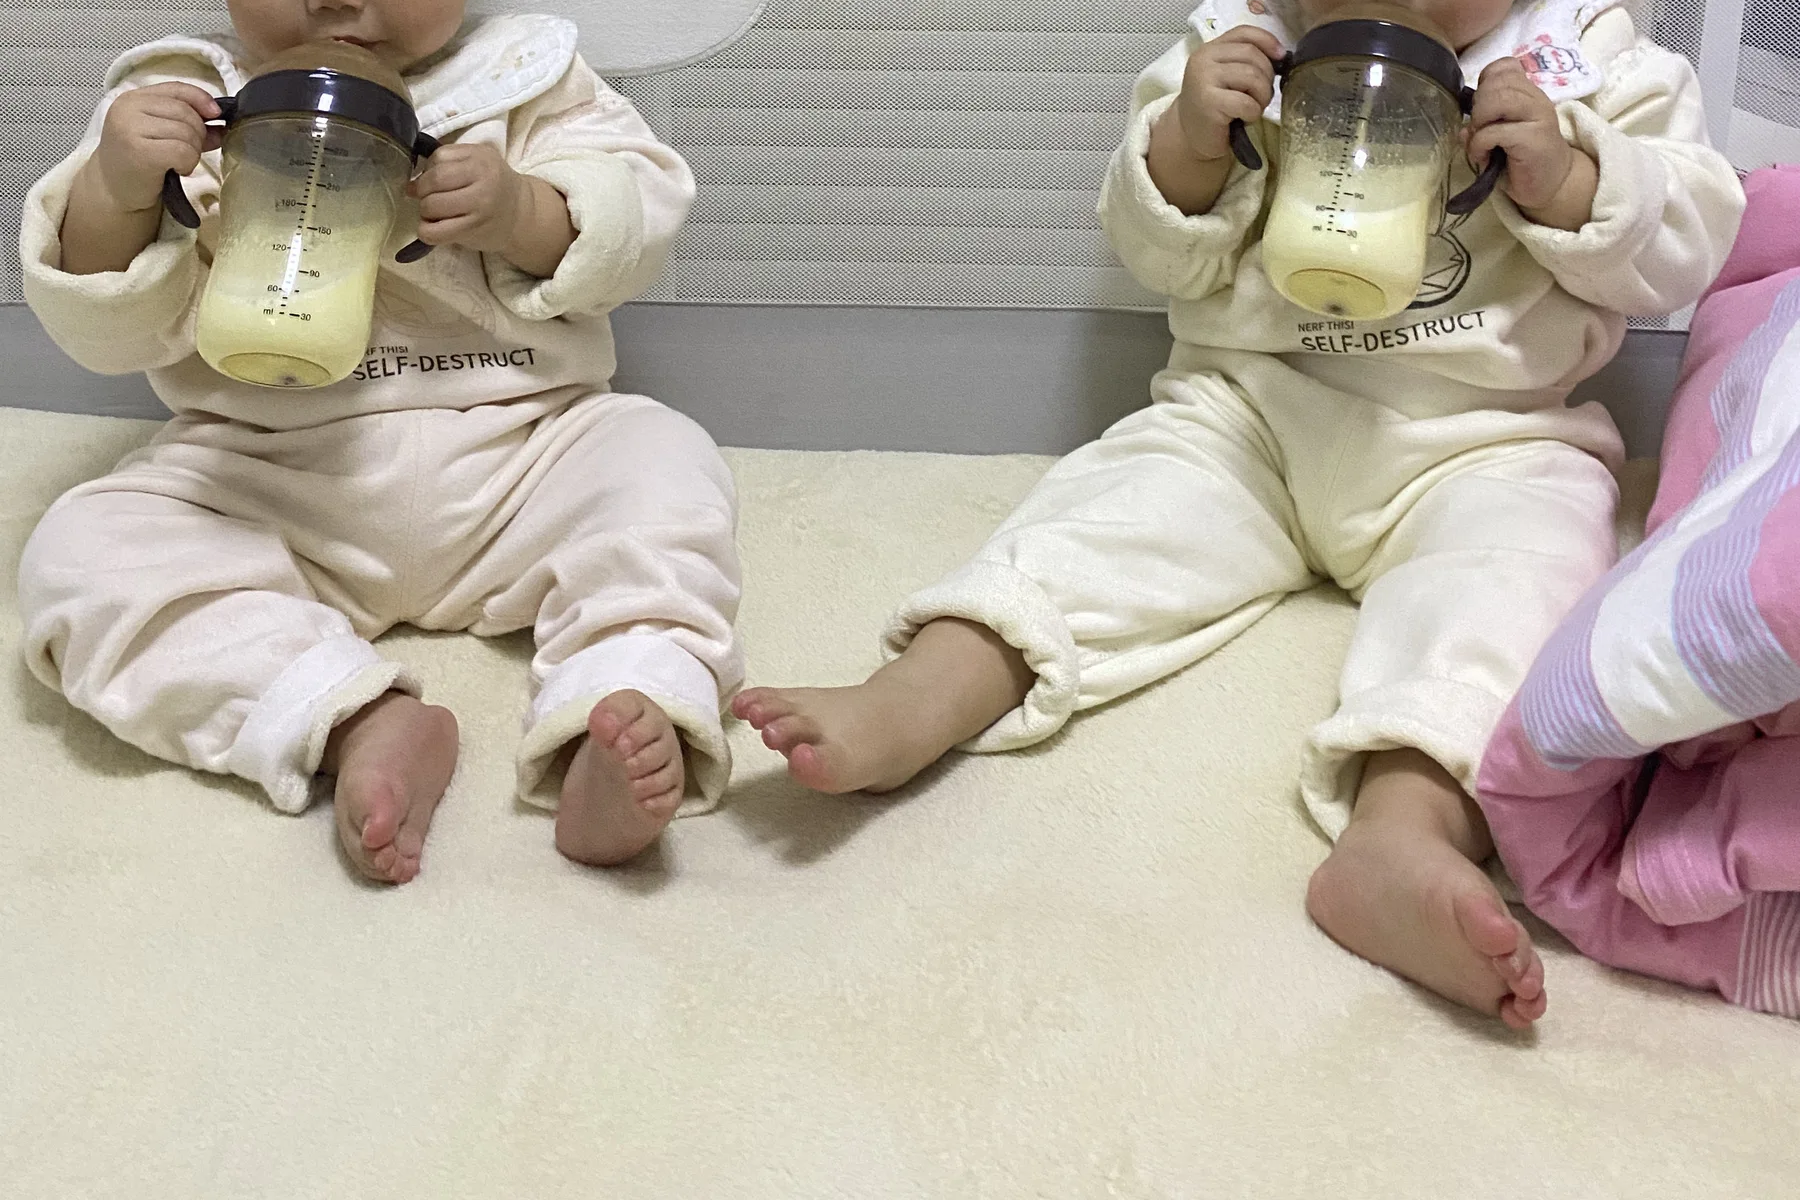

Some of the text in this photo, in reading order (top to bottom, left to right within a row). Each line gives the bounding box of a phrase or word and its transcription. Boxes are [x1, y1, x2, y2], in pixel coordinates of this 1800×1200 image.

[326, 182, 341, 193] 210
[281, 199, 297, 207] 180
[318, 226, 332, 236] 150
[272, 243, 287, 252] 120
[309, 269, 320, 278] 90
[267, 284, 279, 293] 60
[263, 307, 274, 316] ml
[300, 312, 312, 322] 30
[1298, 322, 1325, 332] NERF
[1301, 311, 1485, 353] SELF-DESTRUCT
[352, 348, 536, 381] SELF-DESTRUCT
